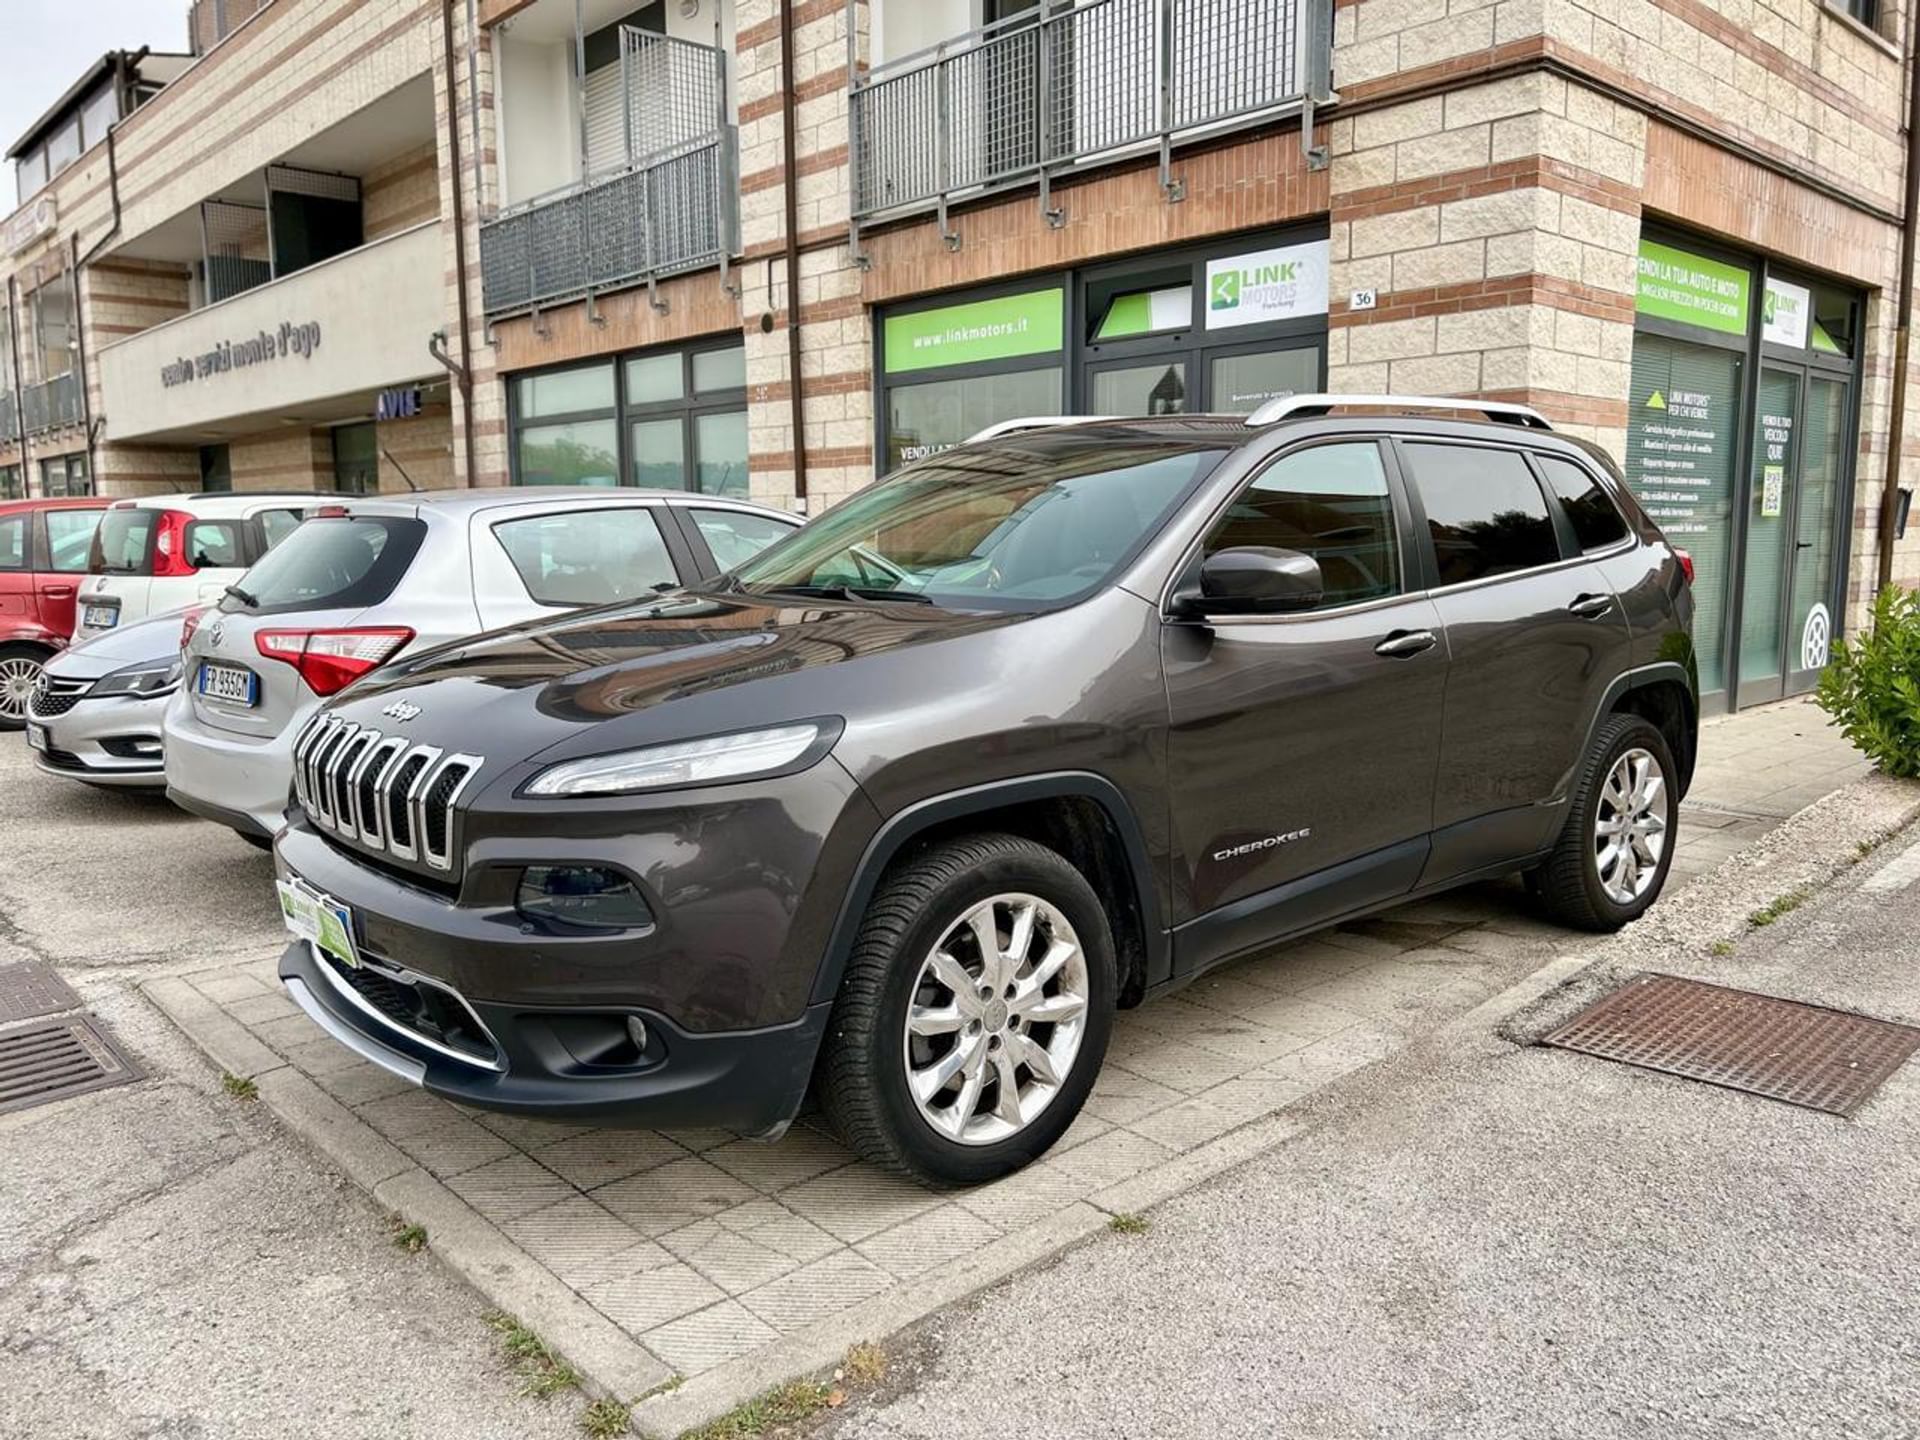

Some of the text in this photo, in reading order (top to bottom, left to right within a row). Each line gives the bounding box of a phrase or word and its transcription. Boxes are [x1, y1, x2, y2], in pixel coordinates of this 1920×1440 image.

[1242, 261, 1296, 287] LINK
[1637, 256, 1660, 278] ENDI
[1241, 282, 1297, 306] MOTORS
[1355, 292, 1371, 306] 36
[913, 315, 1028, 349] www.linkmotors.it
[195, 340, 232, 379] servizi
[232, 330, 276, 369] monte
[277, 320, 321, 359] d'ago
[383, 698, 421, 722] Jeep
[1213, 828, 1311, 861] CHEROKEE
